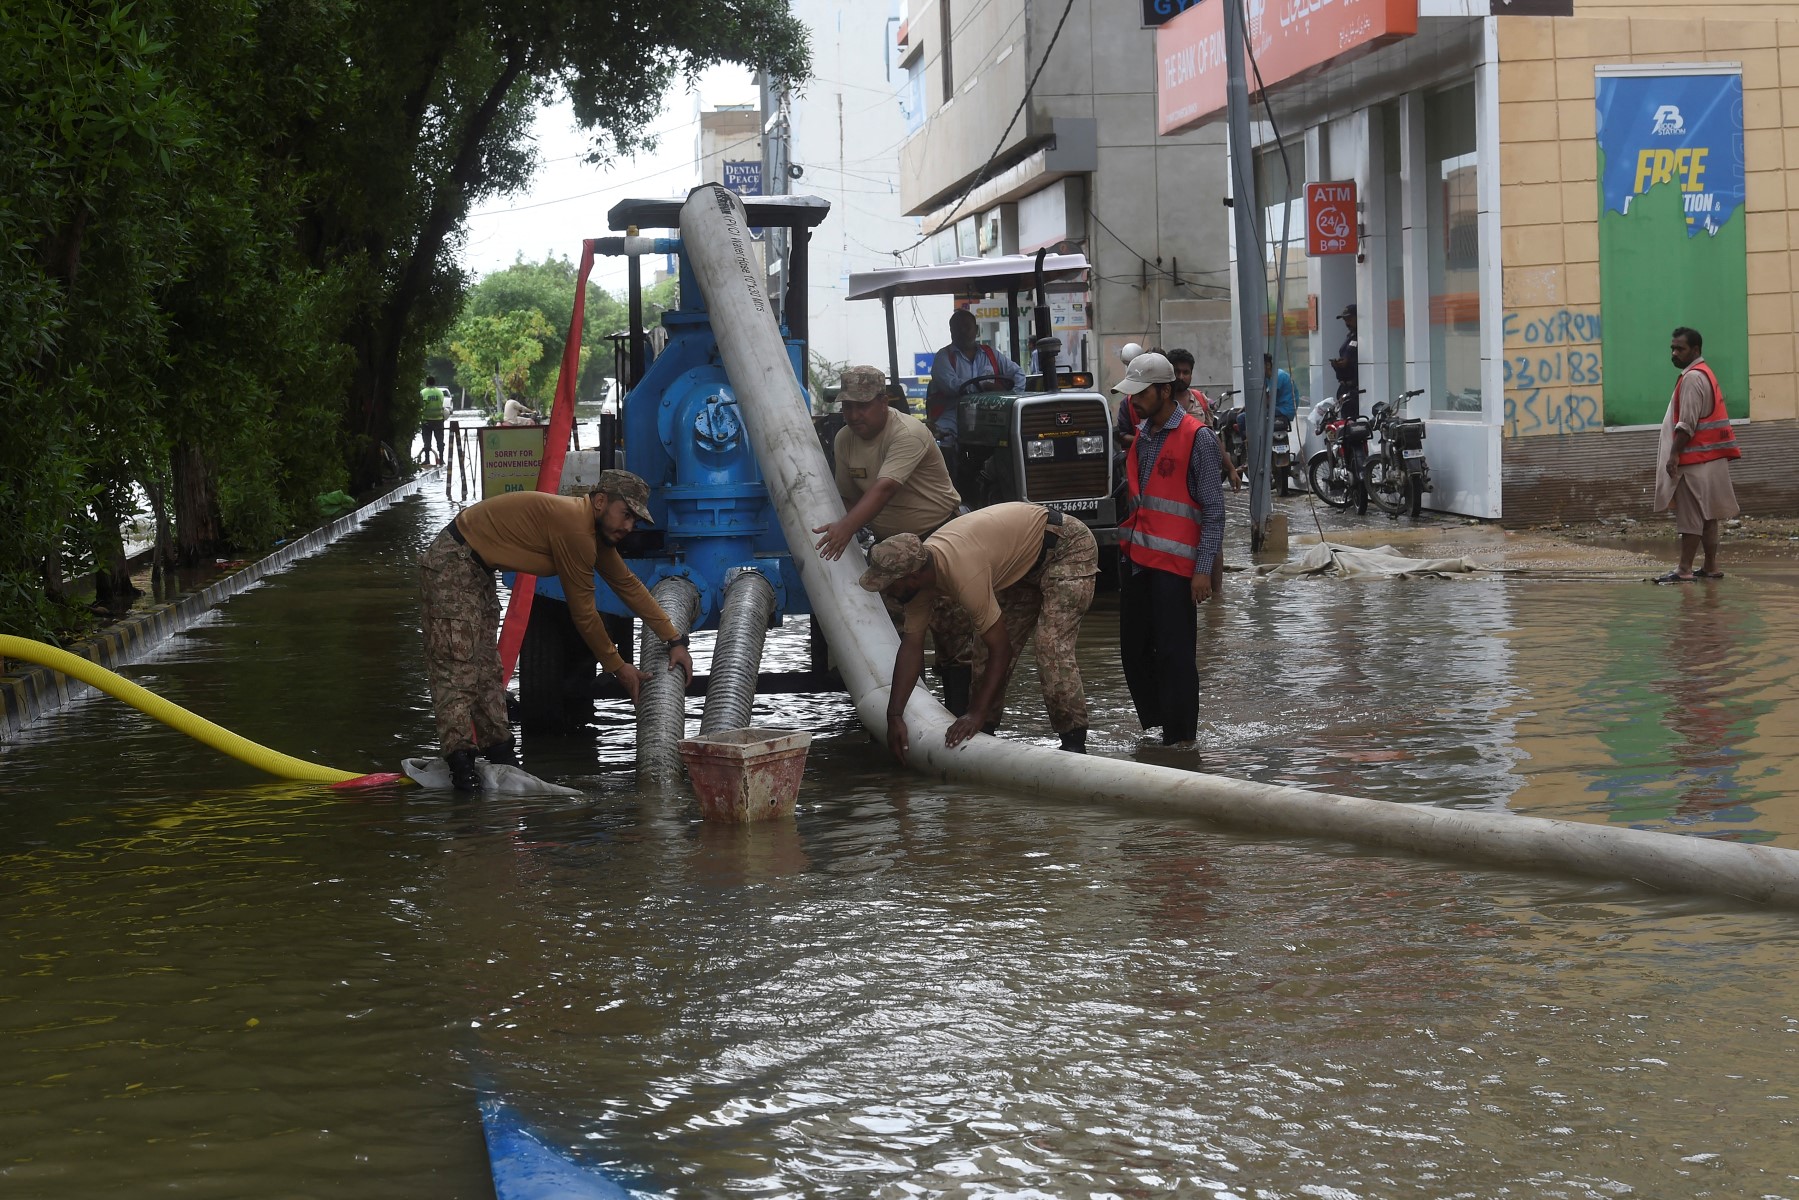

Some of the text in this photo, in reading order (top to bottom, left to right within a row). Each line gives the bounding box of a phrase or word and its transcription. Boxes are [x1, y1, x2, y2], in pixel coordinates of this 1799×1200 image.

[1153, 0, 1203, 15] GY
[1164, 54, 1177, 90] THE
[1177, 43, 1197, 85] BANK
[1197, 37, 1208, 75] OF
[726, 165, 760, 176] DENTAL
[1633, 147, 1709, 194] FREE
[728, 174, 760, 184] PEACE
[1314, 187, 1351, 202] ATM
[974, 305, 1032, 319] SUBWY
[494, 449, 534, 458] SORRY FOR
[486, 459, 542, 469] INCONVENIENCE
[504, 483, 525, 493] DHA
